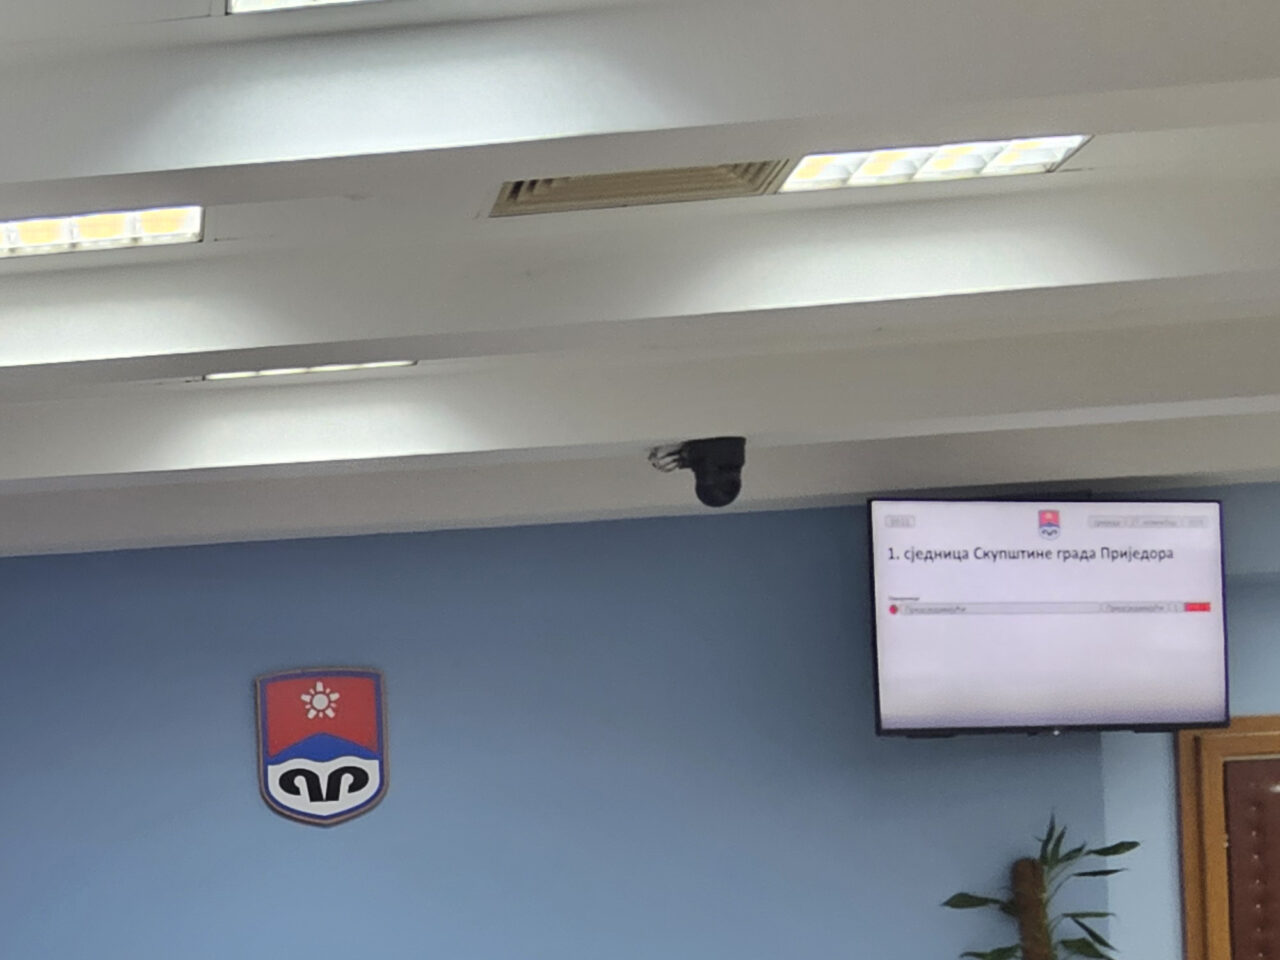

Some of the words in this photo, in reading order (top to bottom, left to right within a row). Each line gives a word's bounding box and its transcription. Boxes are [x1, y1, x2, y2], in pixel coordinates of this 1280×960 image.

[887, 547, 900, 561] 1.
[904, 546, 969, 563] сједница
[973, 546, 1053, 563] Скупштине
[1057, 549, 1097, 563] града
[1100, 546, 1174, 562] Приједора
